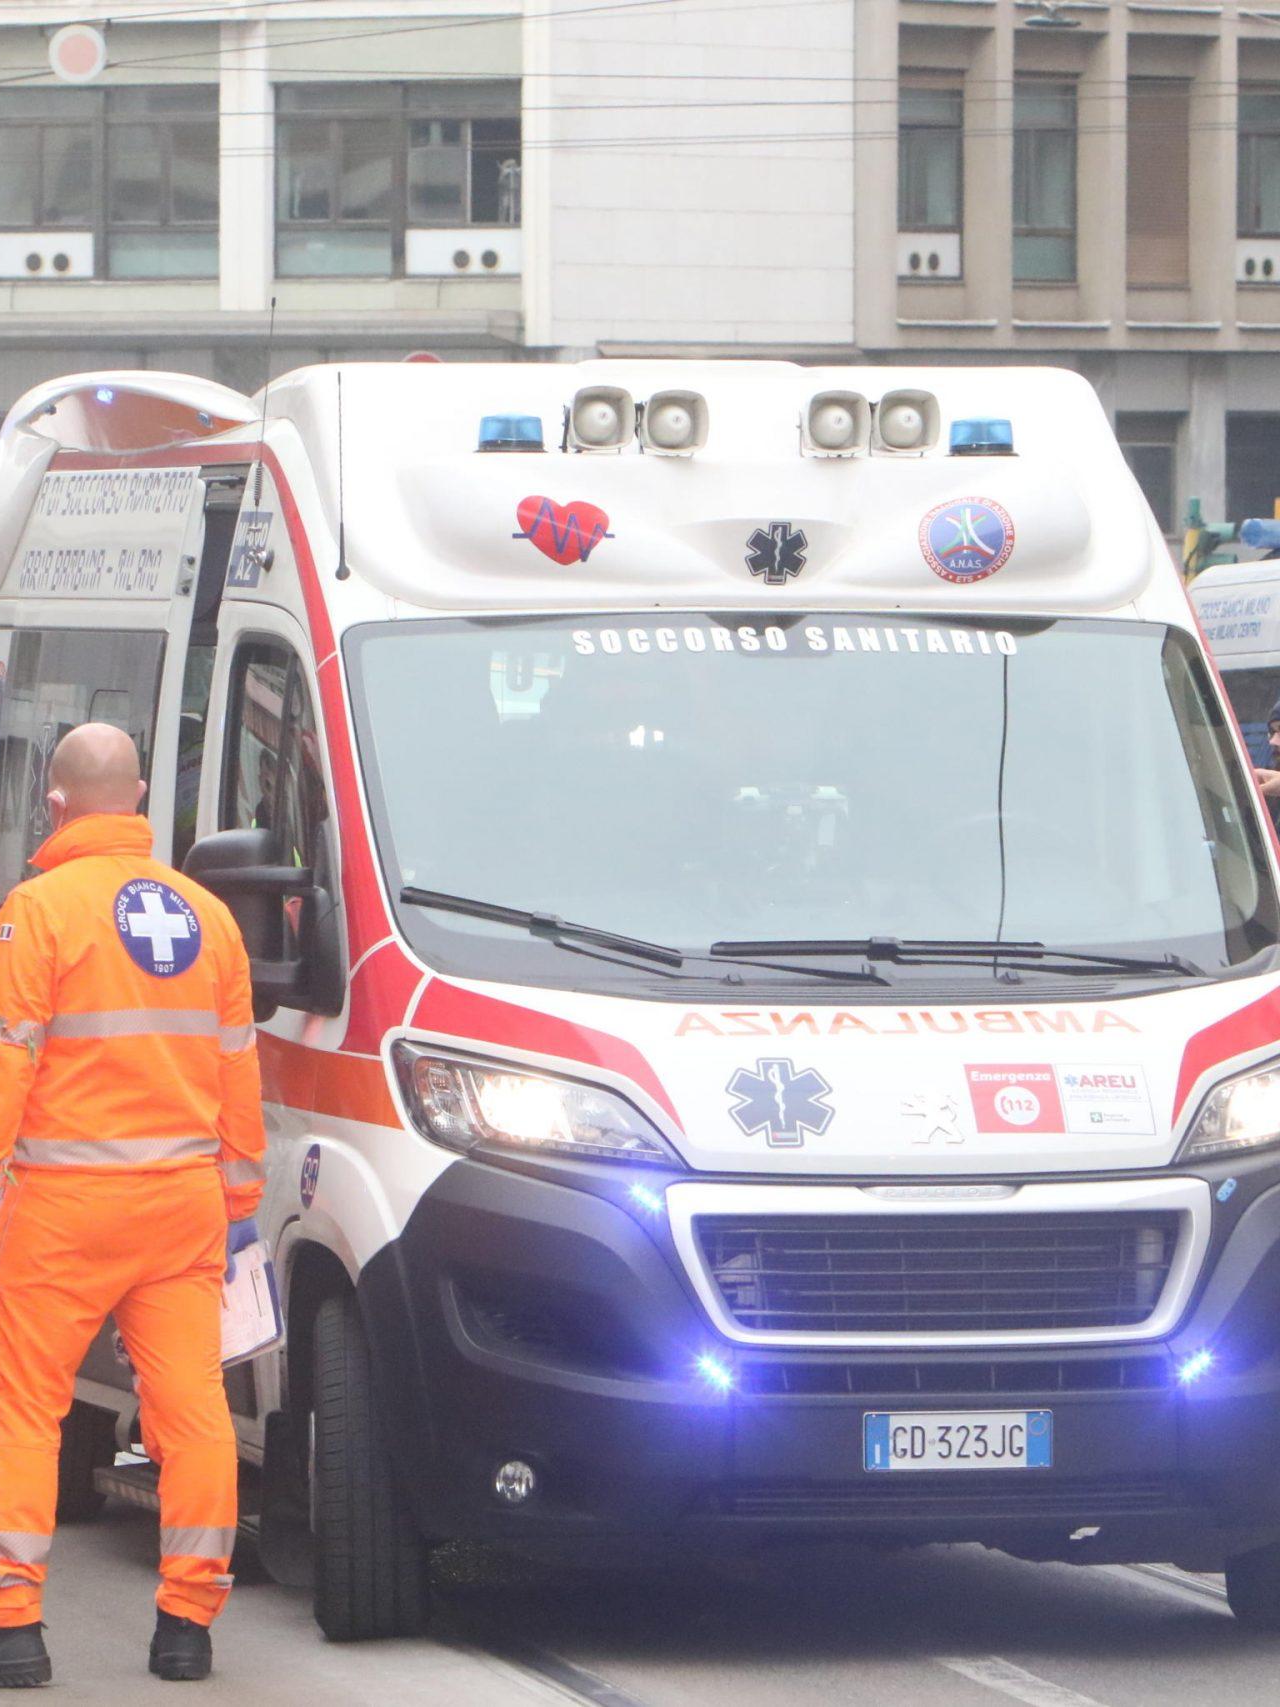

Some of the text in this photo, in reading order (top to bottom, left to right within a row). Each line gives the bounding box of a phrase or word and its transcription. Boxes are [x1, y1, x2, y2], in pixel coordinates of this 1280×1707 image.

[571, 625, 1018, 657] SOCCORSO SANITARIO
[117, 881, 199, 932] CROCE BIANCA MILANO
[153, 963, 176, 973] 1907
[970, 1070, 1051, 1084] Emergenza
[1079, 1075, 1136, 1089] AREU
[1007, 1099, 1035, 1112] 112
[892, 1424, 1024, 1459] GD 323JG
